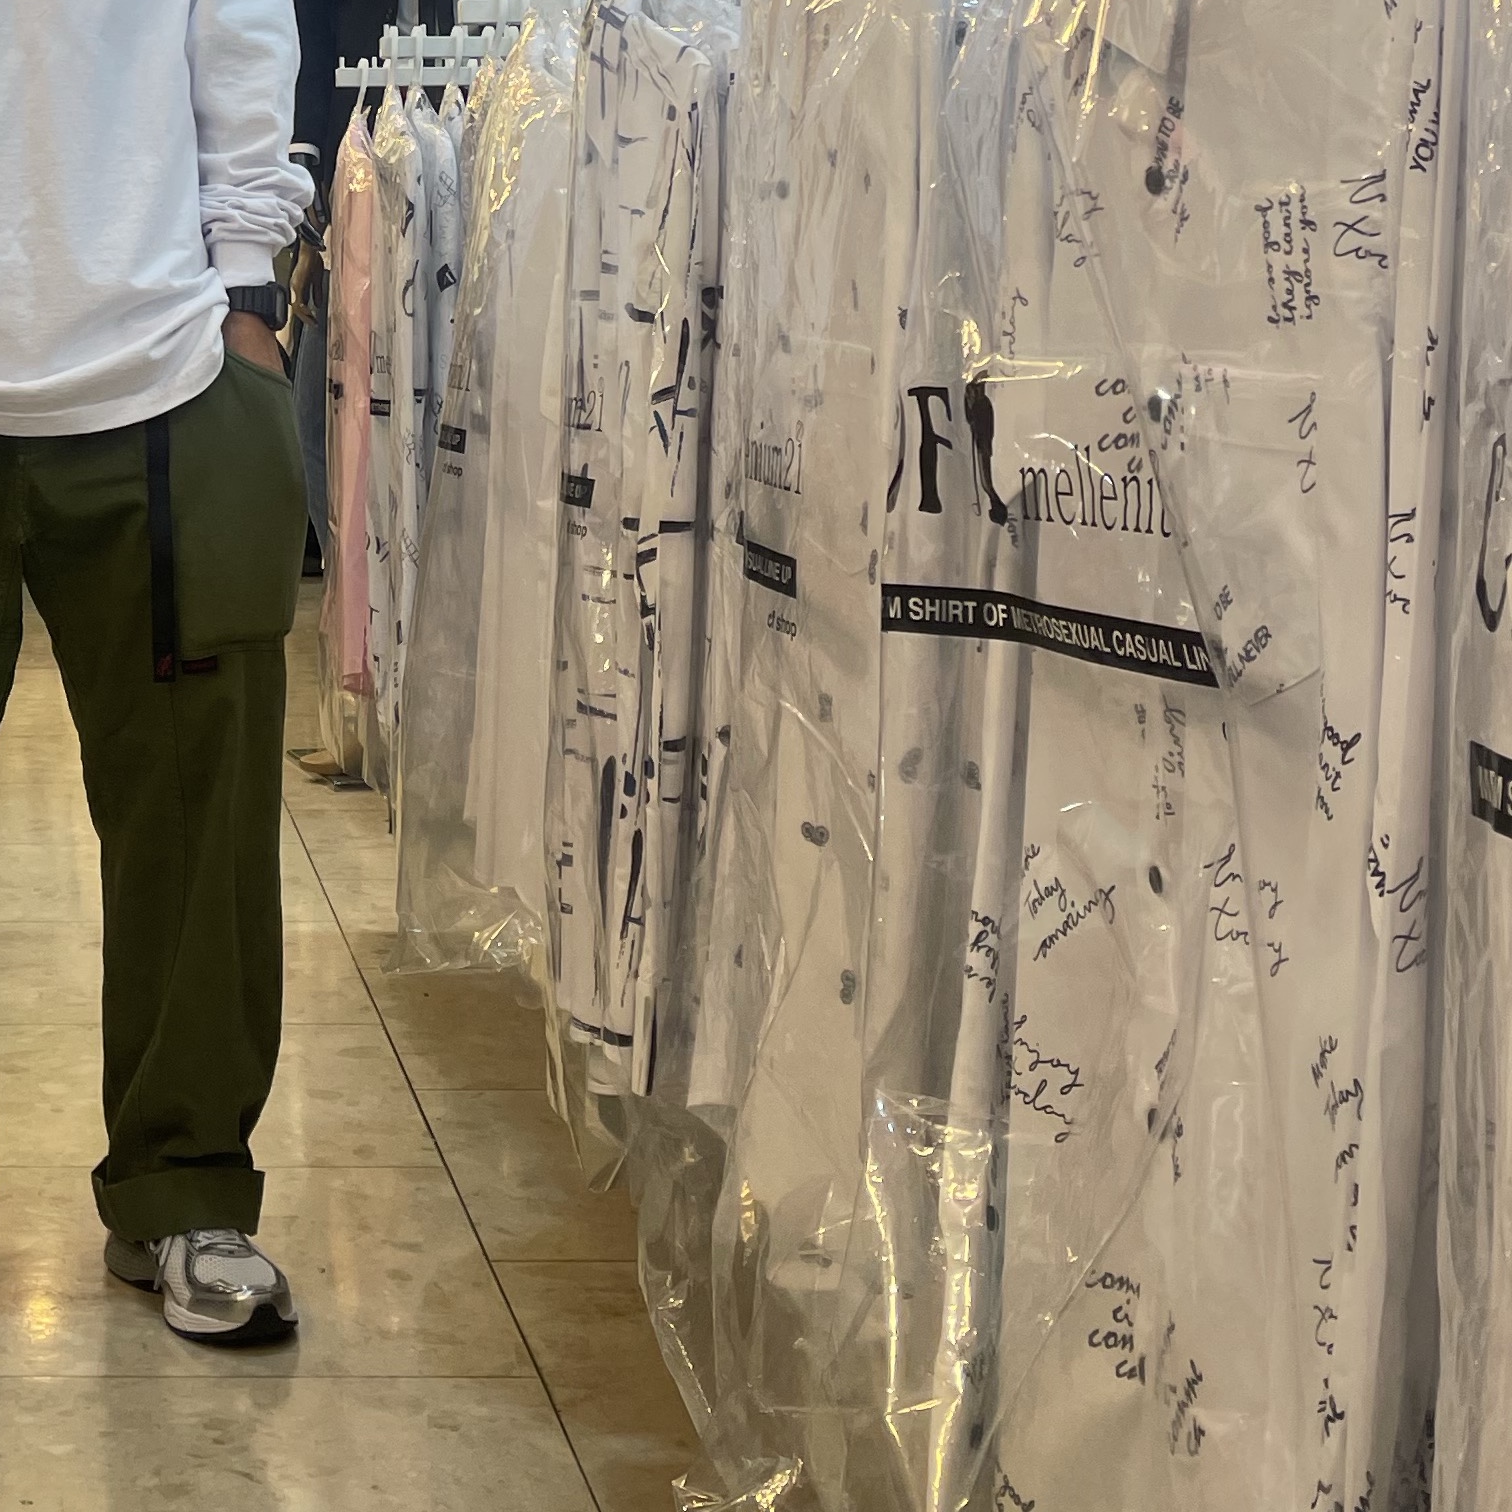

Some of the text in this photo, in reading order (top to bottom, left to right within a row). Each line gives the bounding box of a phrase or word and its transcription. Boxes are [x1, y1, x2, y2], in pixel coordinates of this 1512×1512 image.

[1254, 197, 1281, 255] good
[1299, 184, 1321, 321] ignore you
[1280, 264, 1304, 326] they
[907, 596, 978, 625] SHIRT
[982, 602, 1009, 628] OF
[1010, 605, 1112, 654] METROSEXUAL
[1112, 630, 1183, 668] CASUAL
[1237, 624, 1273, 667] NEVER
[1023, 876, 1067, 921] Today
[1032, 884, 1117, 962] amazing
